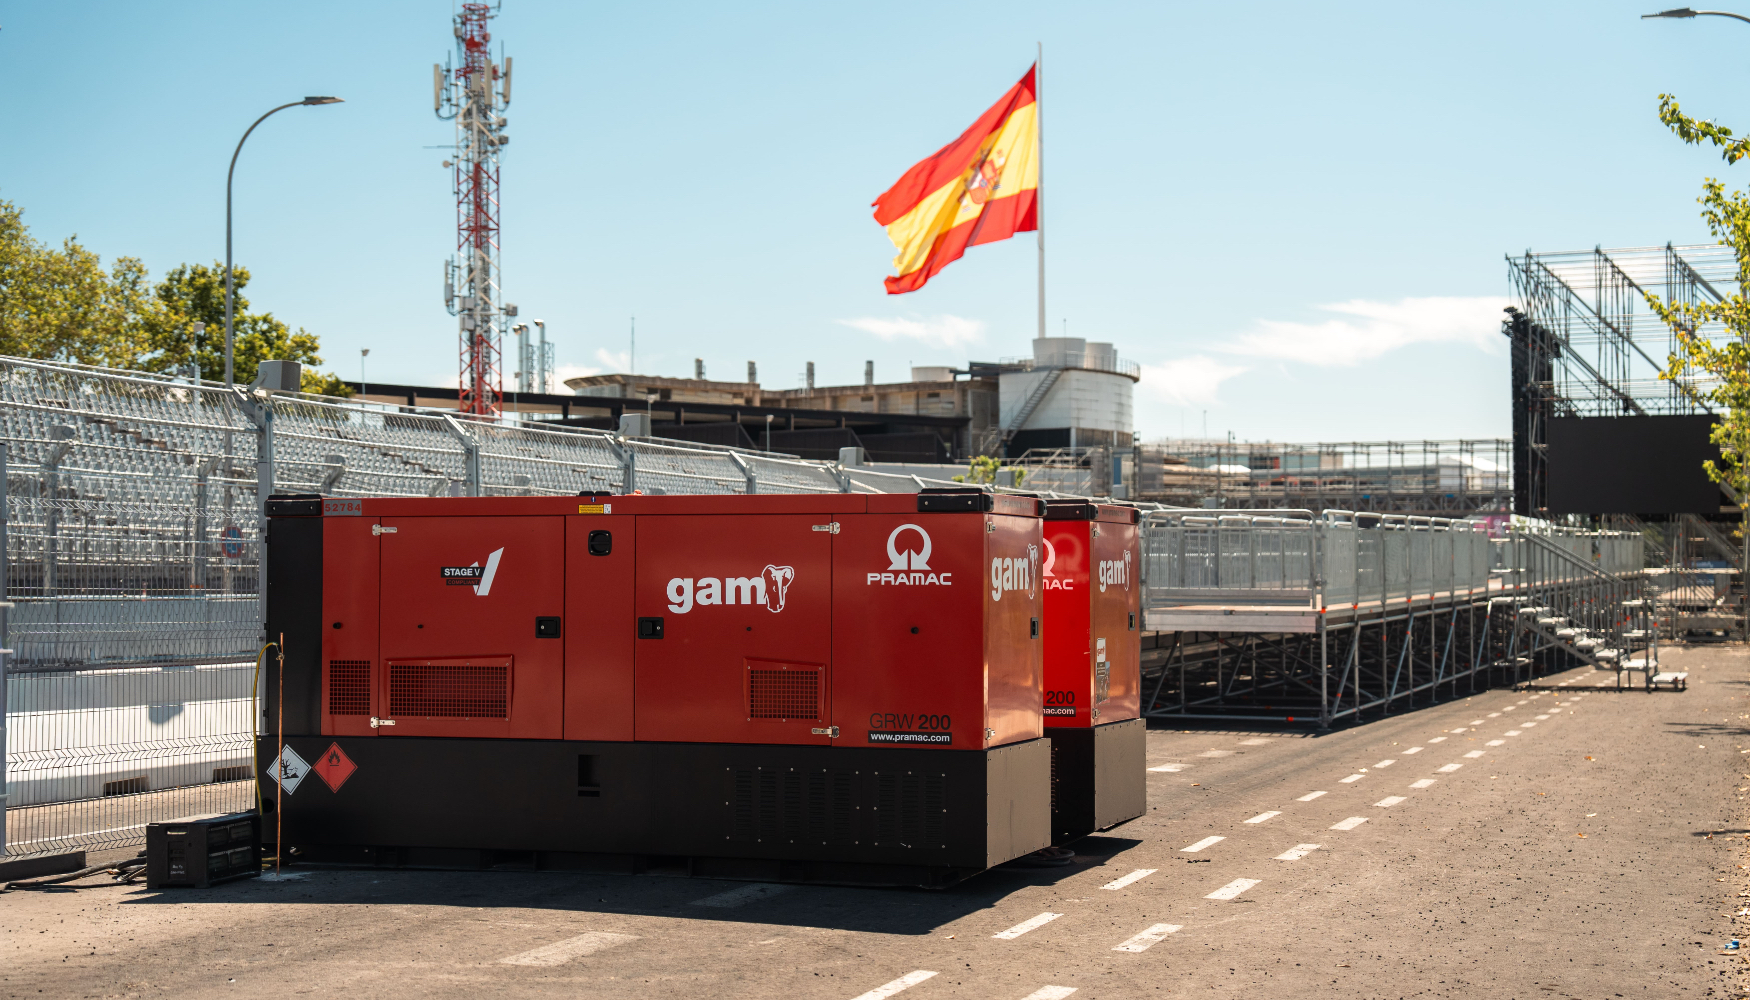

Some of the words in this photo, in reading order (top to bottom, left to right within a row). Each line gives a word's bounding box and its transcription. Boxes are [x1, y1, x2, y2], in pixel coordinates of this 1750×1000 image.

[325, 503, 361, 512] 52784
[444, 568, 473, 576] STAGE
[474, 568, 480, 576] V
[1099, 560, 1125, 592] gam
[867, 573, 951, 585] PRAMAC
[992, 557, 1029, 601] gam
[666, 577, 766, 614] gam
[1046, 691, 1075, 704] 200
[869, 713, 914, 729] GRW
[918, 714, 951, 730] 200
[870, 733, 950, 742] www.pramac.com
